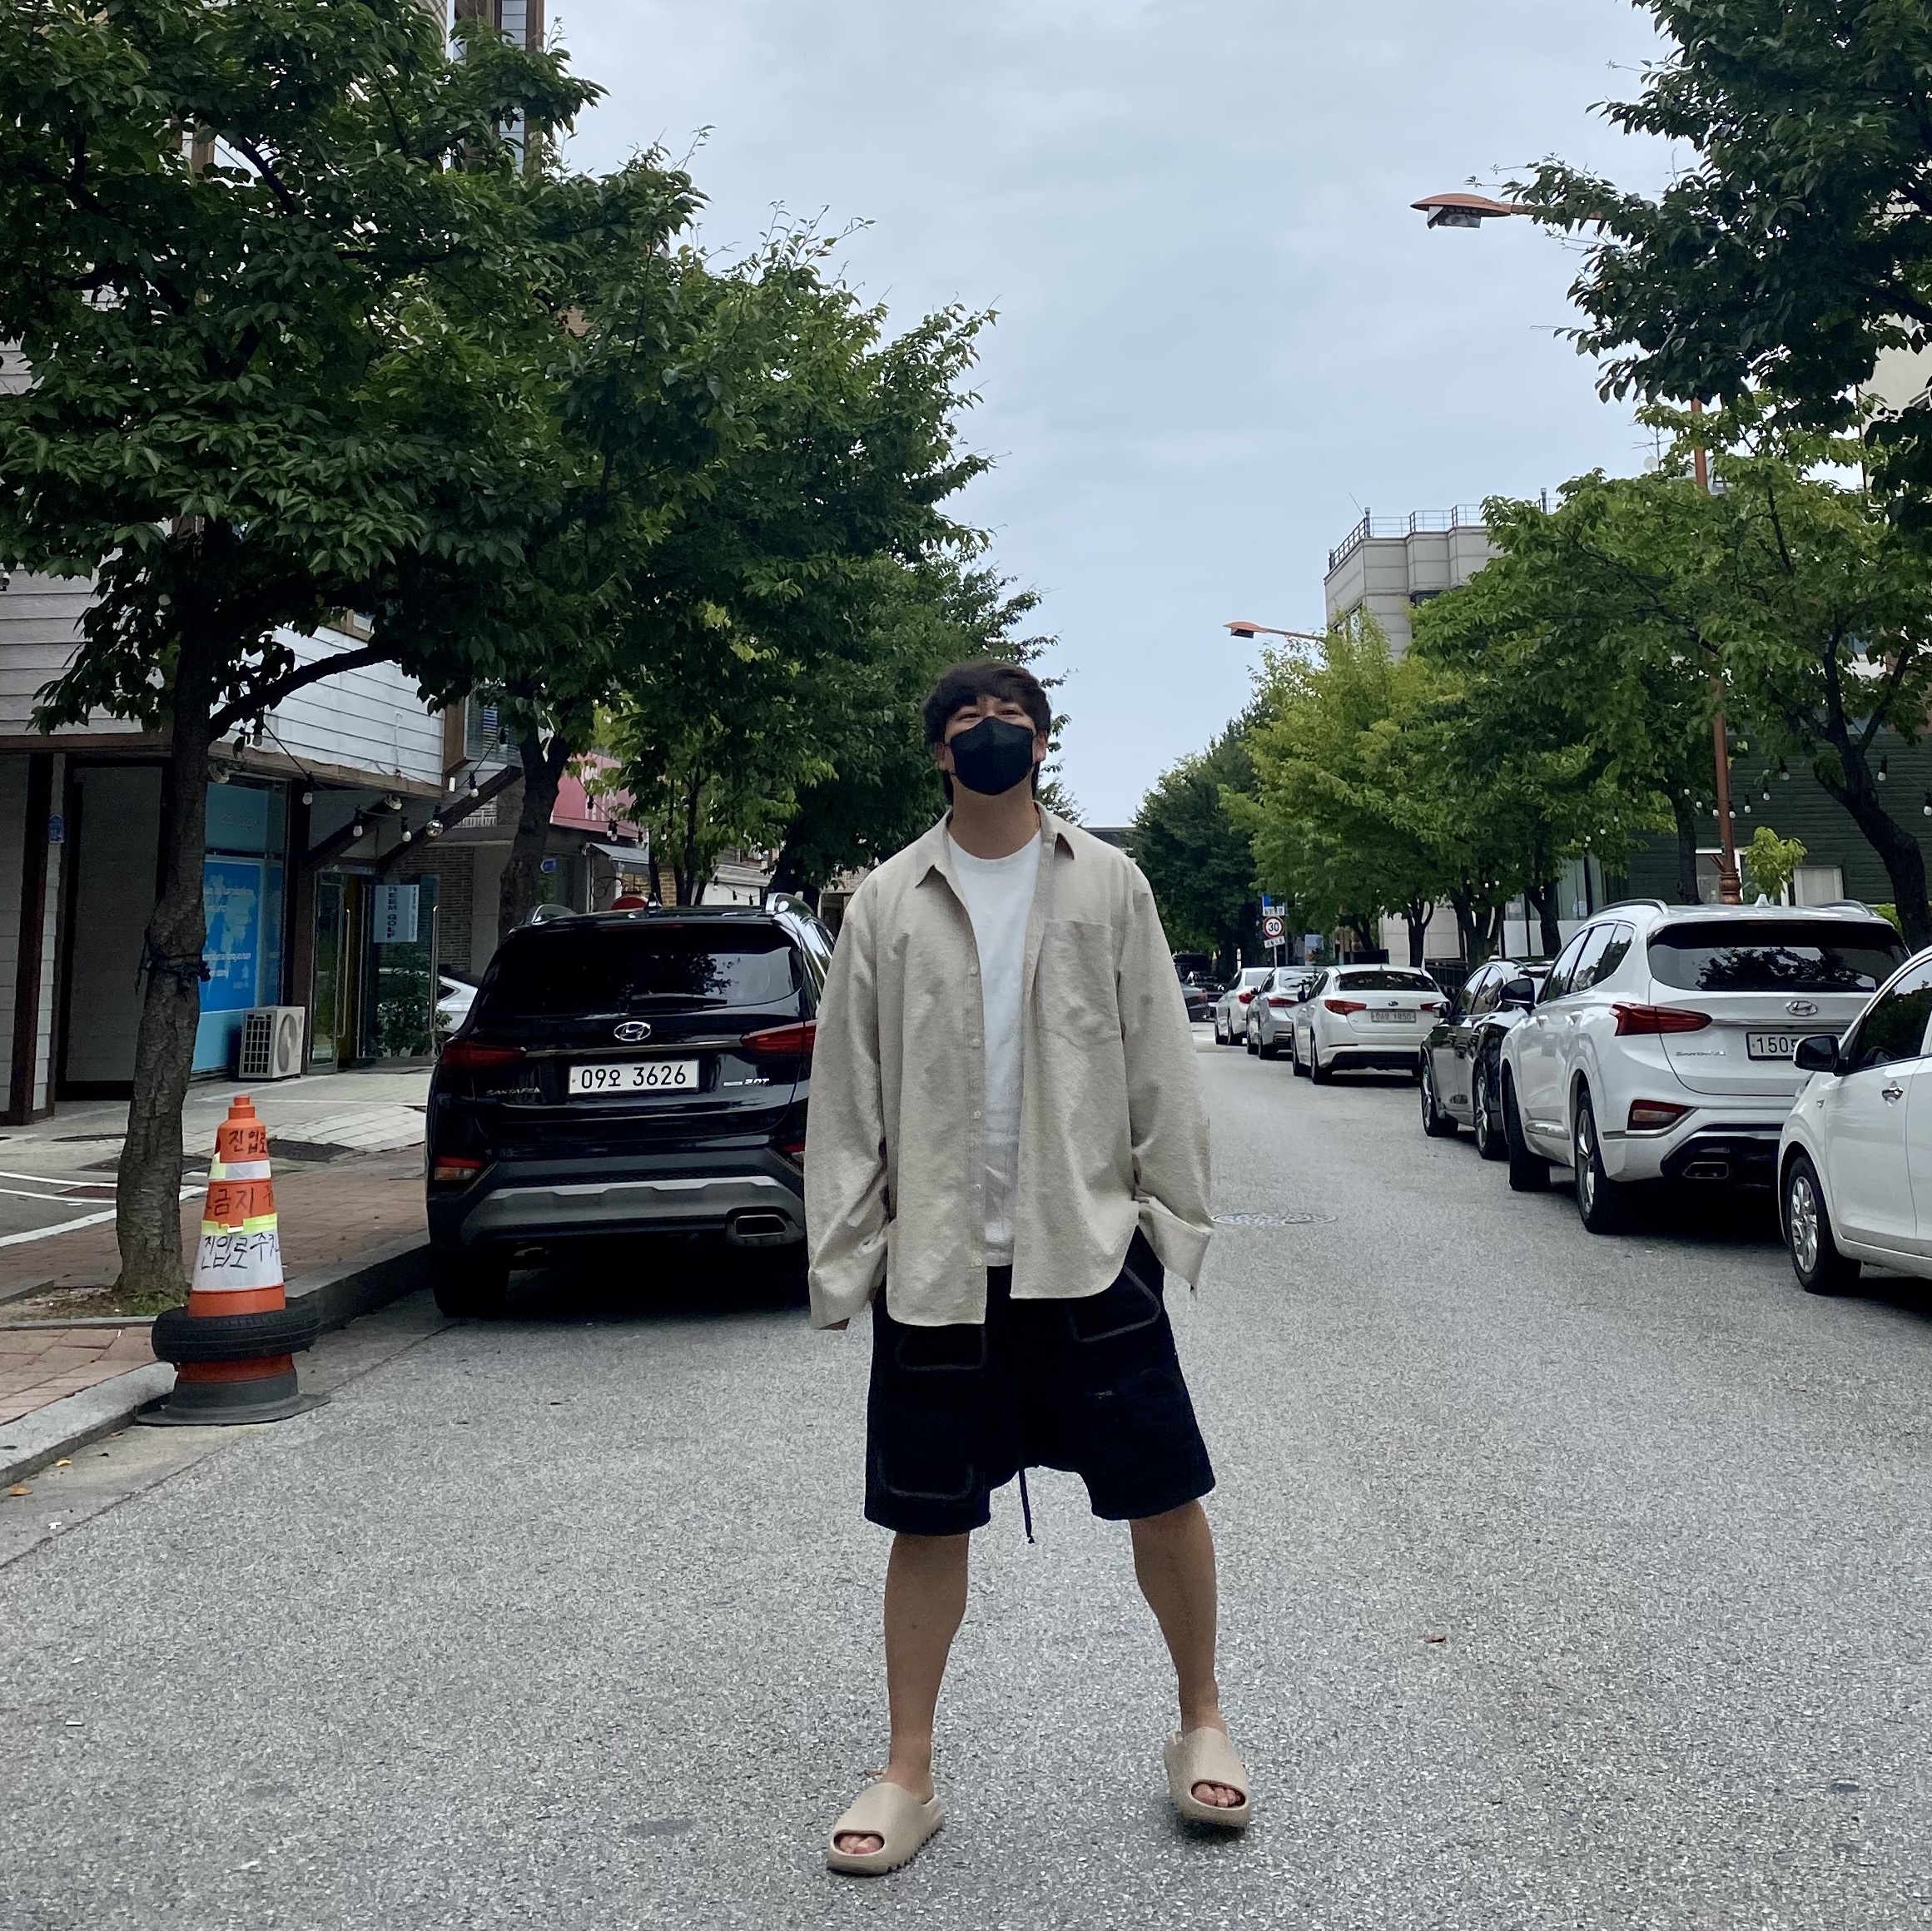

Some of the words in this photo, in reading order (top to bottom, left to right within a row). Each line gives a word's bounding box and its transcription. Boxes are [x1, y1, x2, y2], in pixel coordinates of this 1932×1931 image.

[1268, 921, 1279, 932] 30
[581, 1068, 621, 1089] 09오
[633, 1065, 687, 1086] 3626
